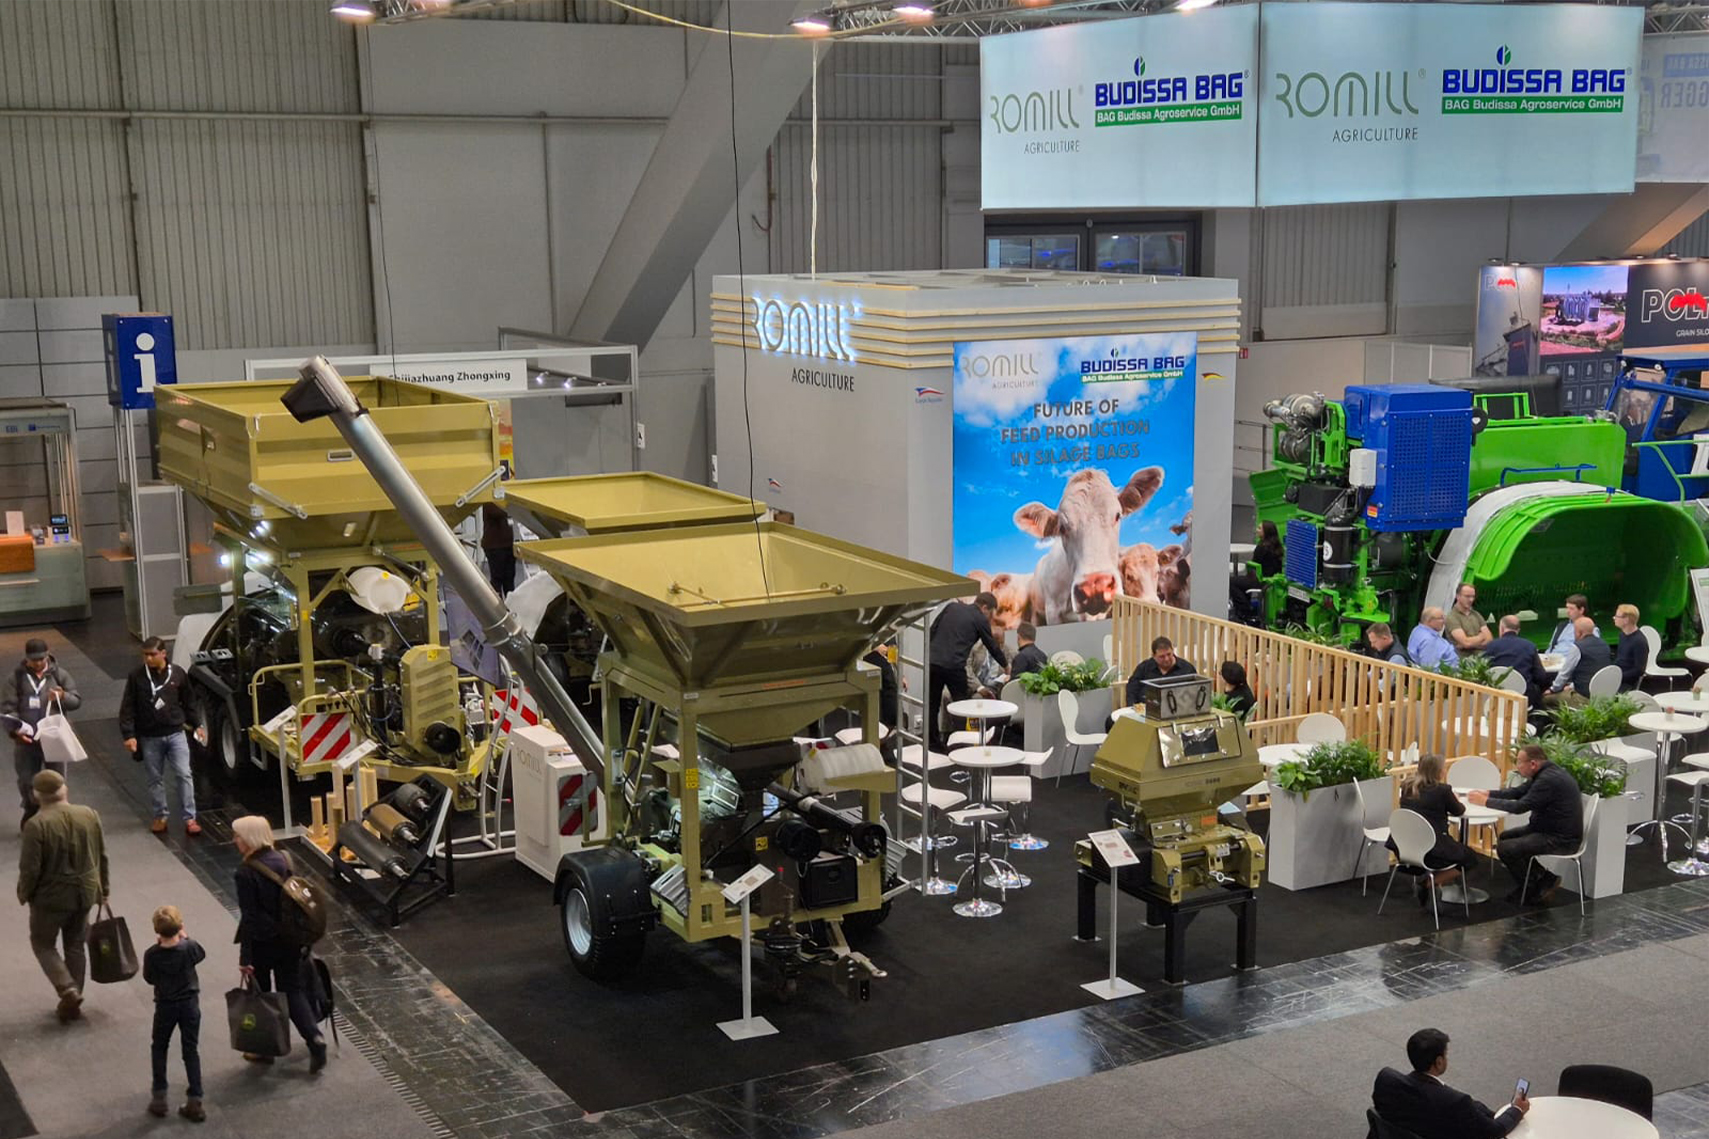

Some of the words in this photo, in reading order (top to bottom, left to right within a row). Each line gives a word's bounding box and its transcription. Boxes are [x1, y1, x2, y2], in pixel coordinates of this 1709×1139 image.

[1095, 76, 1187, 107] BUDISSA
[1194, 72, 1243, 101] BAG
[1442, 69, 1562, 93] BUDISSA
[1571, 69, 1625, 93] BAG
[1275, 71, 1419, 118] ROMILL
[1445, 100, 1470, 110] BAG
[1473, 99, 1518, 110] Budissa
[1520, 98, 1586, 111] Agroservice
[1588, 98, 1621, 109] GmbH
[990, 88, 1080, 134] ROMILL
[1097, 112, 1115, 123] BAG
[1118, 109, 1151, 121] Budissa
[1154, 107, 1208, 121] Agroservice
[1210, 104, 1240, 116] GmbH
[1333, 127, 1419, 143] AGRICULTURE
[1024, 140, 1080, 155] AGRICULTURE
[751, 297, 852, 362] ROMILL
[1676, 328, 1696, 338] GRAIN
[962, 353, 1039, 379] ROMILL
[1080, 357, 1148, 374] BUDISSA
[1153, 355, 1185, 369] BAG
[389, 373, 455, 384] ijiazhuang
[456, 370, 511, 383] Zhongxing
[792, 367, 855, 392] AGRICULTURE
[1033, 400, 1093, 419] FUTURE
[1098, 398, 1120, 414] OF
[1001, 427, 1041, 445] FEED
[1046, 420, 1150, 441] PRODUCTION
[1011, 450, 1030, 467] IN
[1035, 446, 1091, 465] SILAGE
[1097, 443, 1141, 461] BAGS
